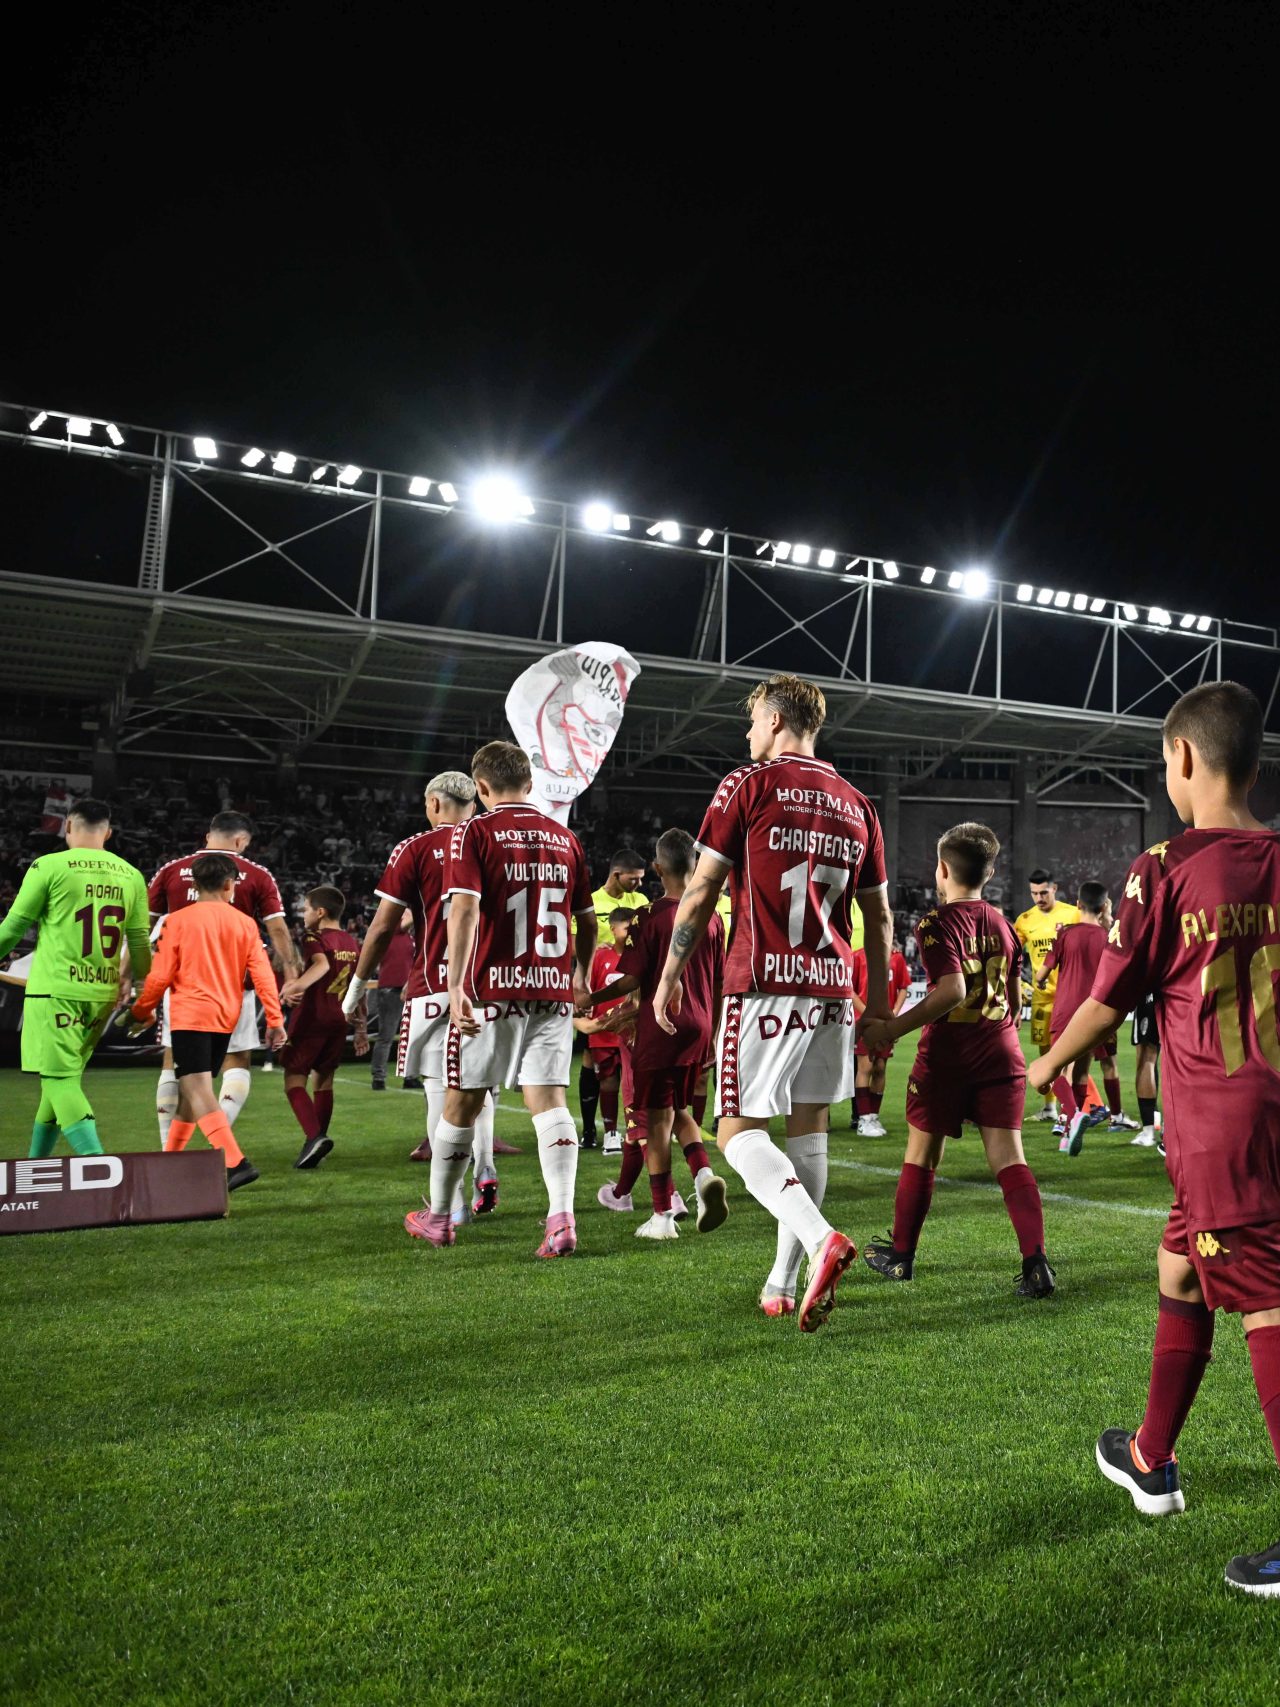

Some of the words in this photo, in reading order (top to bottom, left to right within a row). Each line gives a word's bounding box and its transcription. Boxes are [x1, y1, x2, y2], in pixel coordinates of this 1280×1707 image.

[776, 788, 865, 821] HOFFMAN
[783, 805, 832, 818] UNDERFLOOR
[834, 815, 862, 828] HEATING
[494, 829, 570, 848] HOFFMAN
[546, 845, 569, 854] HEATING
[68, 860, 134, 875] HOFFMAN
[504, 863, 568, 883] VULTURAR
[780, 860, 849, 951] 17
[75, 903, 126, 958] 16
[507, 887, 568, 959] 15
[327, 963, 350, 1001] 4
